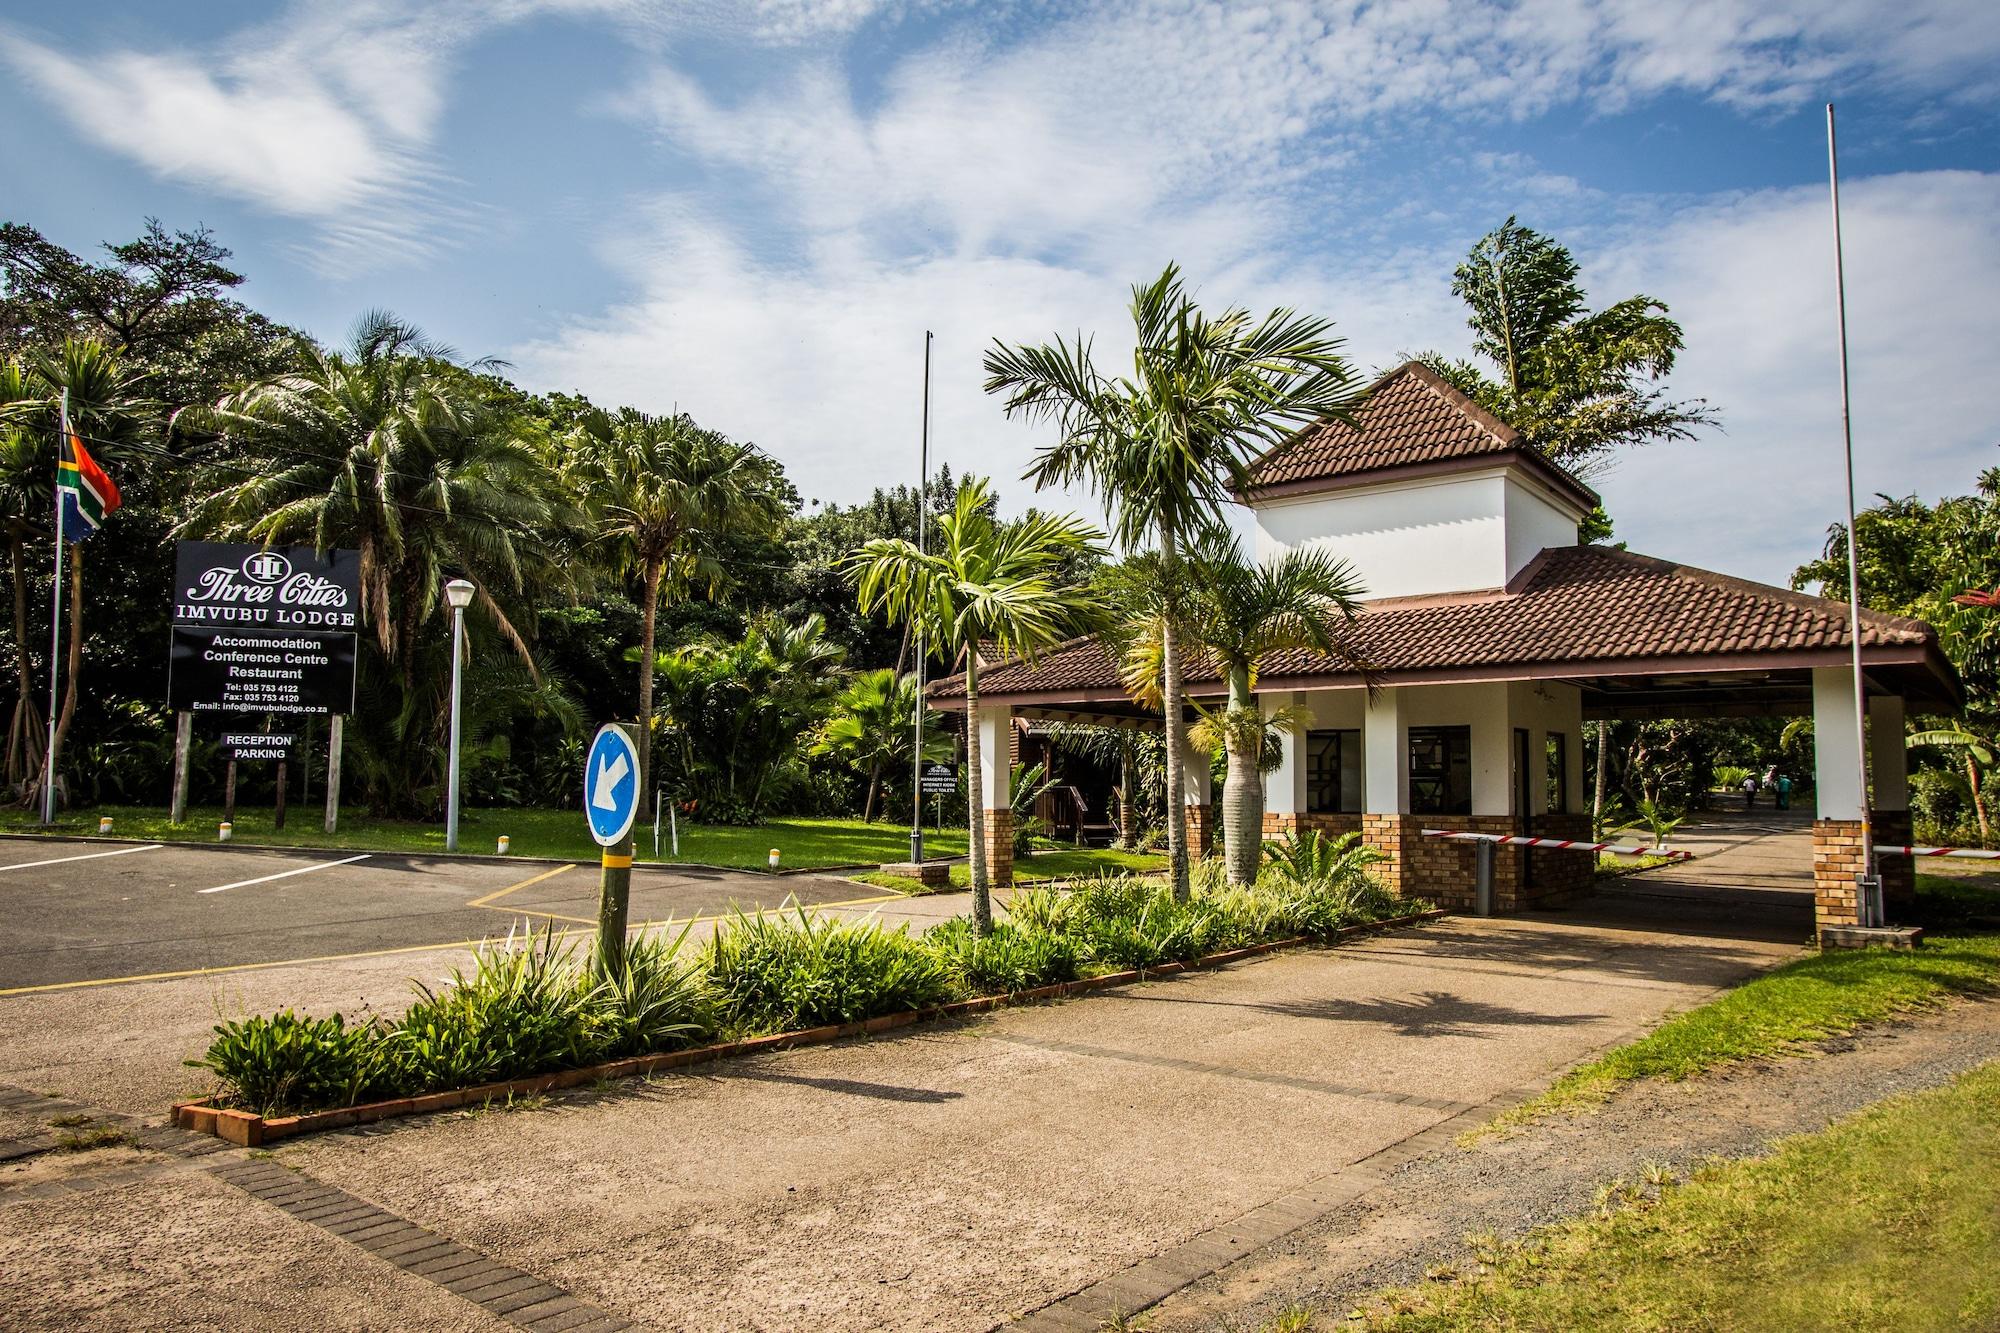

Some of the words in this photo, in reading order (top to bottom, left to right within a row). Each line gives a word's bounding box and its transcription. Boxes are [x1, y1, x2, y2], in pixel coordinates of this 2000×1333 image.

[187, 567, 274, 602] Three
[280, 572, 348, 607] Cities
[177, 604, 269, 622] IMVUBU
[277, 609, 355, 627] LODGE
[212, 635, 322, 650] Accommodation
[203, 650, 281, 664] Conference
[284, 653, 329, 665] Centre
[229, 666, 303, 679] Restaurant
[225, 683, 242, 691] Tel:
[243, 684, 259, 692] 035
[260, 684, 276, 692] 753
[277, 685, 299, 693] 4122
[223, 693, 243, 701] Fax:
[244, 693, 260, 701] 035
[261, 694, 277, 702] 753
[193, 702, 221, 710] Email:
[222, 703, 328, 713] info@imvubulodge.co.za
[226, 735, 292, 746] RECEPTION
[234, 749, 286, 759] PARKING
